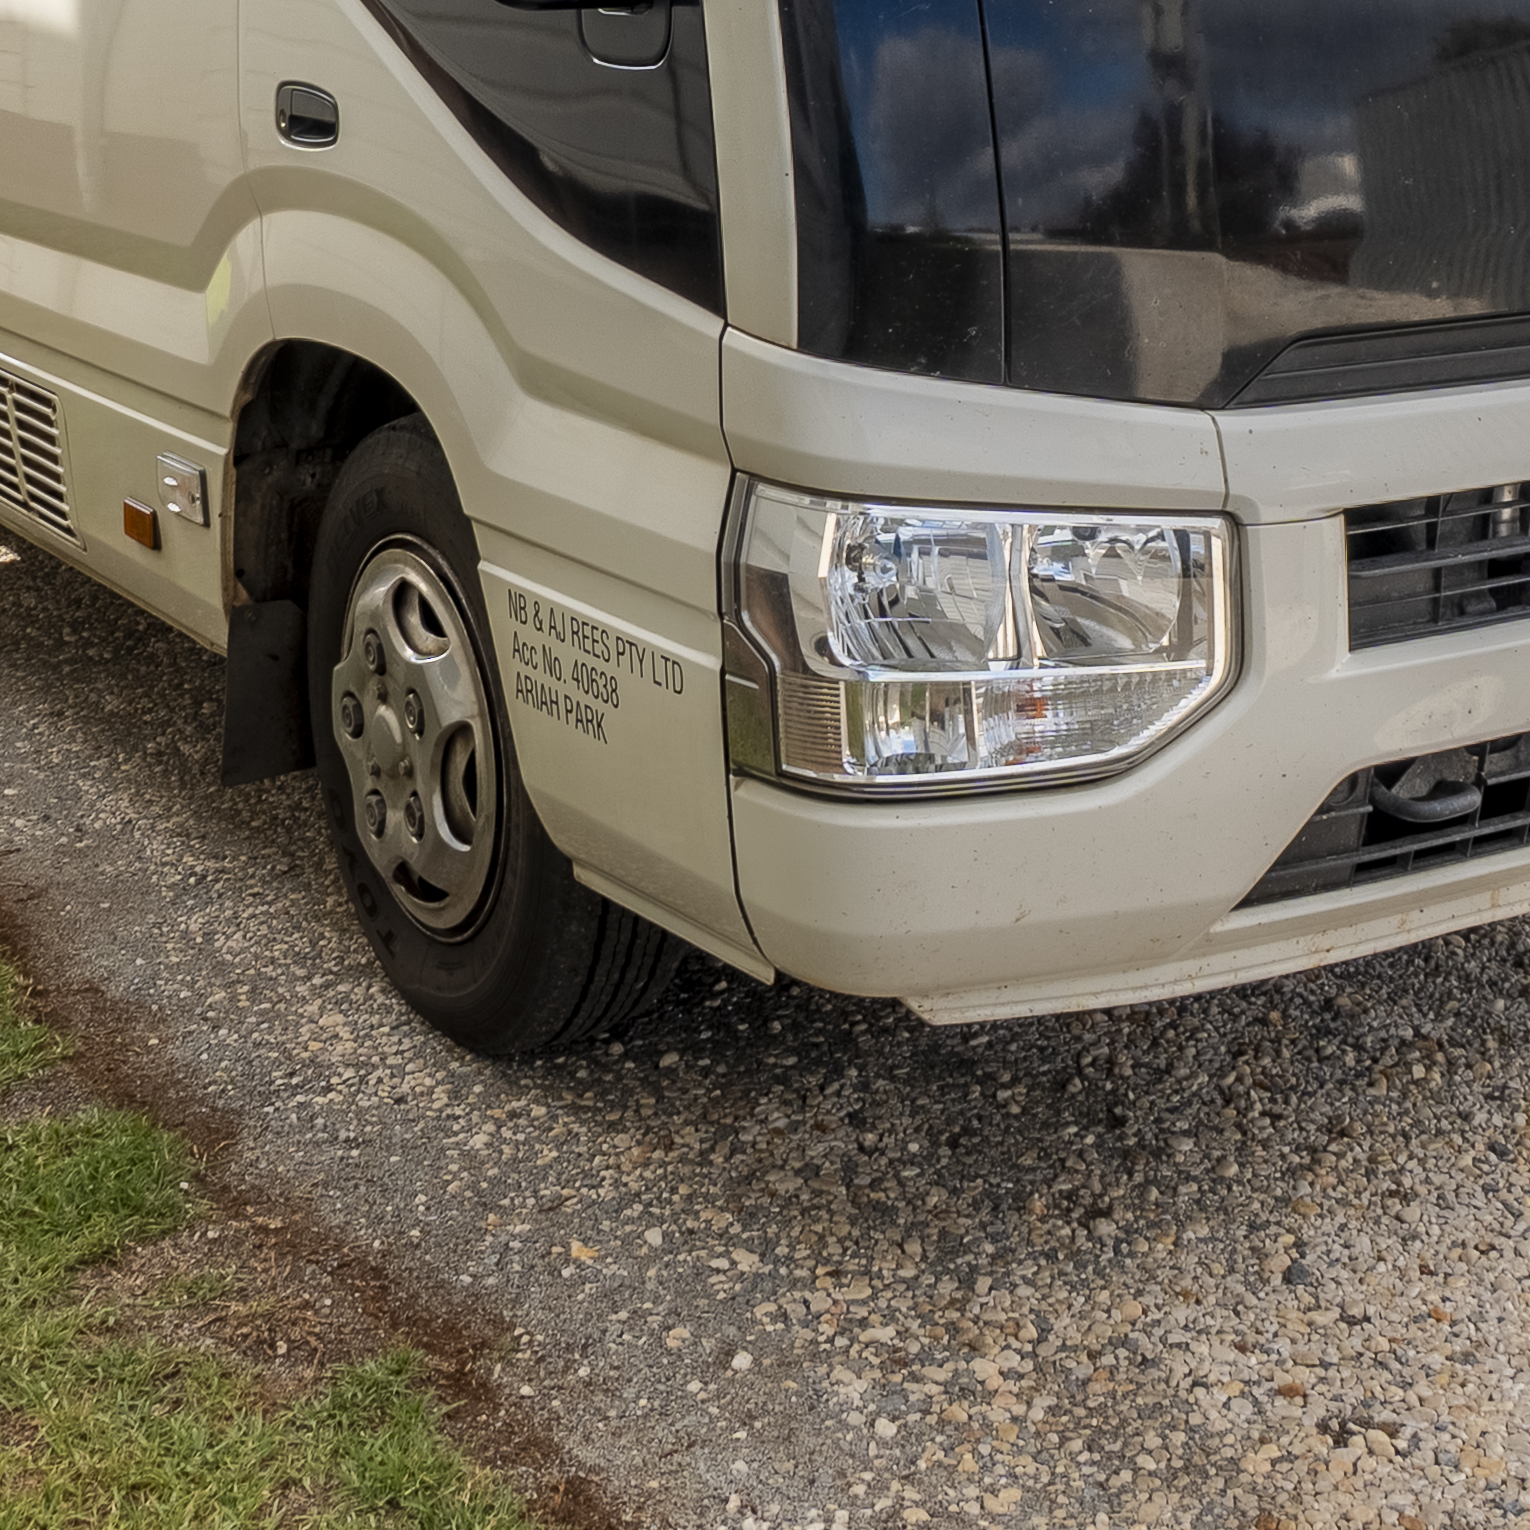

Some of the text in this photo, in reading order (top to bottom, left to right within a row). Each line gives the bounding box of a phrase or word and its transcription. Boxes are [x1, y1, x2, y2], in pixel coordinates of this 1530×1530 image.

[507, 588, 684, 695] NB & AJ REES PTY LTD
[512, 631, 620, 709] Acc No. 40638
[516, 671, 608, 745] ARIAH PARK
